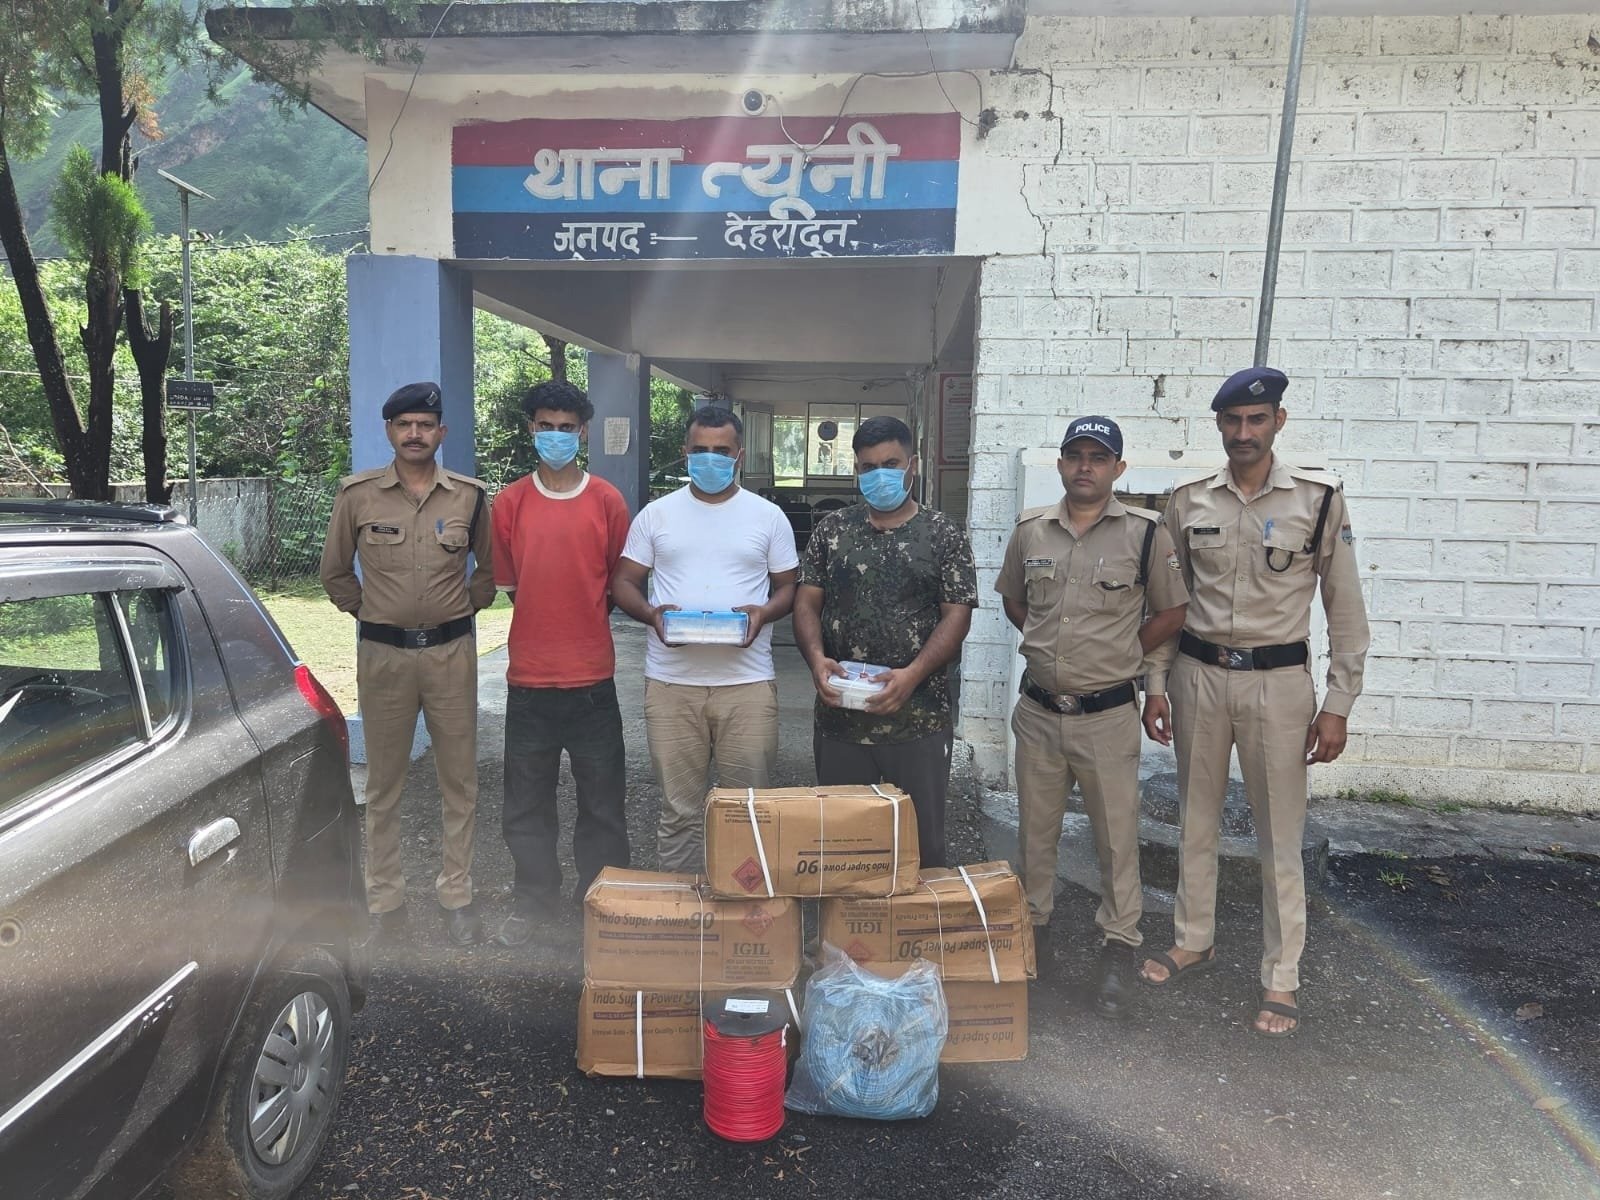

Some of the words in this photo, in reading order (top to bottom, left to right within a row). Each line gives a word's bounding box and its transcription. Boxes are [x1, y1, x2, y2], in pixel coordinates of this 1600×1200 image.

[523, 148, 684, 200] थाना
[702, 122, 901, 220] त्यूनी
[553, 222, 646, 254] जनपद
[724, 212, 857, 256] देहरादून
[1075, 423, 1110, 435] POLICE
[796, 860, 818, 874] 90
[847, 862, 870, 872] Super
[871, 862, 890, 872] Indo
[599, 911, 621, 924] Indo
[622, 913, 652, 928] Super
[656, 915, 689, 928] Power
[688, 912, 715, 930] 90
[846, 922, 881, 934] IGIL
[733, 944, 770, 955] IGIL
[898, 940, 922, 959] 90
[959, 938, 988, 953] Super
[990, 938, 1012, 952] Indo
[593, 992, 616, 1004] Indo
[619, 992, 648, 1006] Supr
[650, 992, 683, 1004] Power
[962, 1030, 990, 1044] Super
[992, 1032, 1014, 1044] Indo
